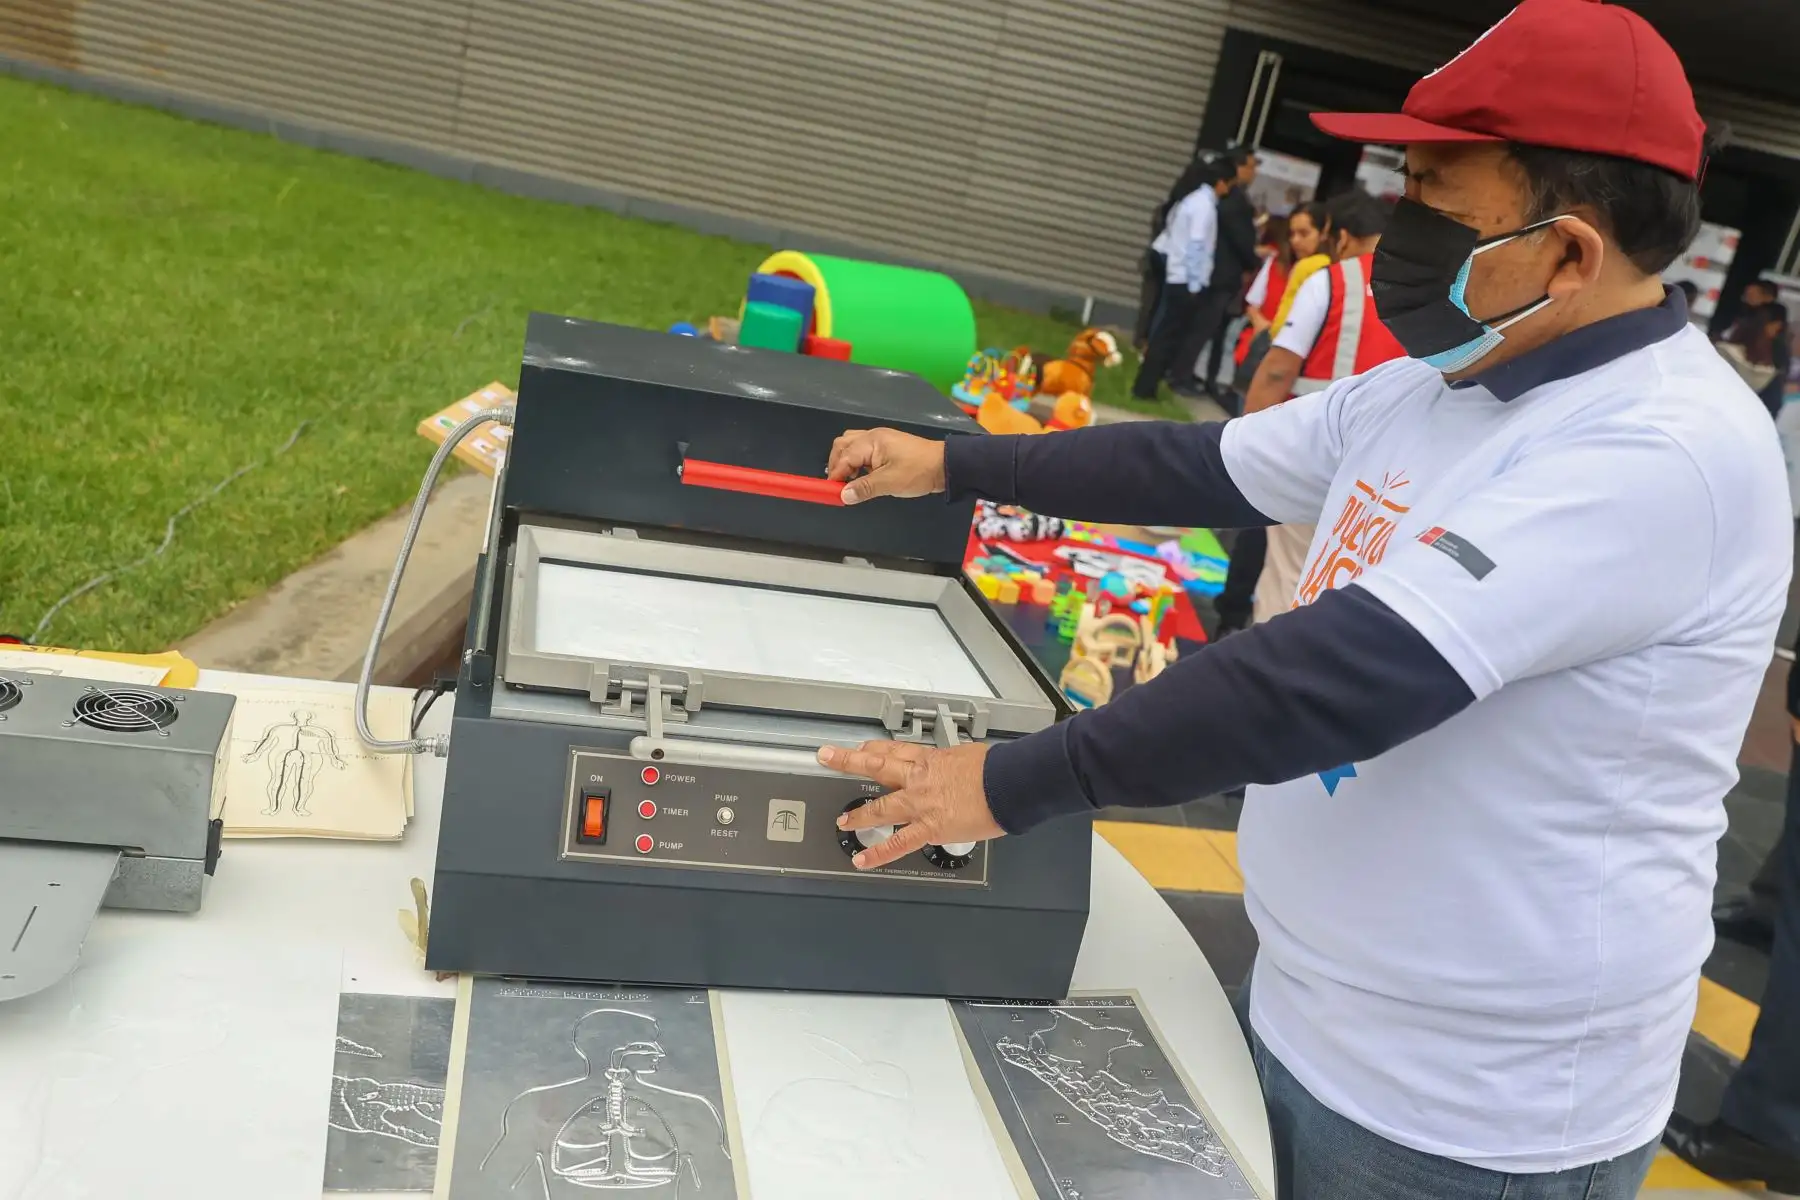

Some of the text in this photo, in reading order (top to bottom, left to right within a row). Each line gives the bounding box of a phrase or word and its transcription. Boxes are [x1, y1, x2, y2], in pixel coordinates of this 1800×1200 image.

[590, 774, 604, 783] ON
[664, 774, 697, 784] POWER
[860, 784, 881, 793] TIME
[714, 793, 739, 803] PUMP
[662, 807, 689, 817] TIMER
[710, 828, 740, 838] RESET
[658, 841, 684, 850] PUMP
